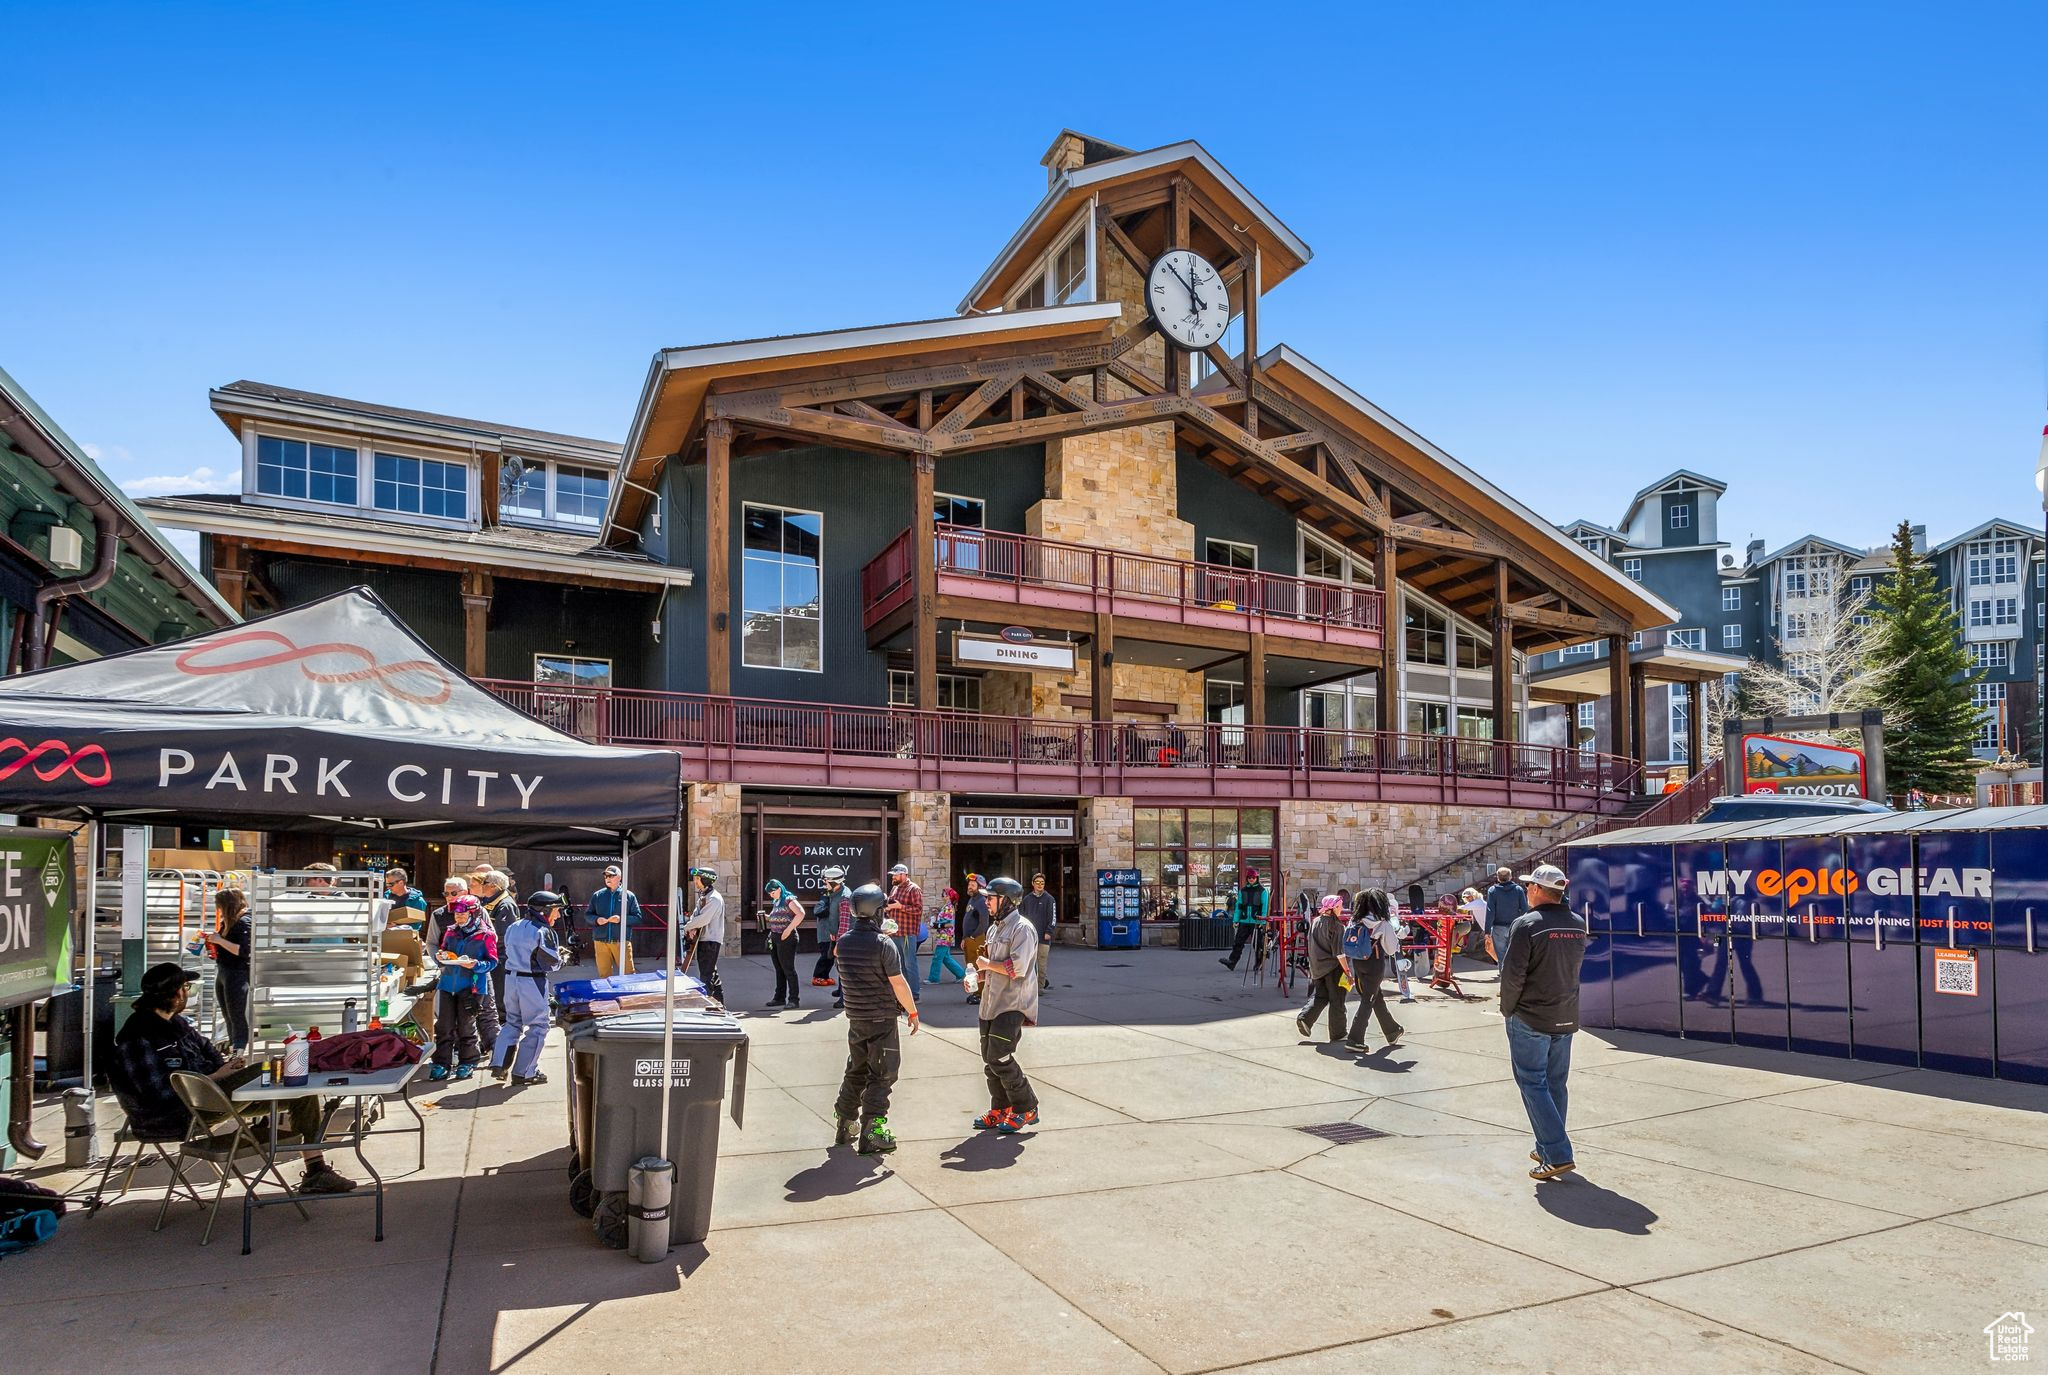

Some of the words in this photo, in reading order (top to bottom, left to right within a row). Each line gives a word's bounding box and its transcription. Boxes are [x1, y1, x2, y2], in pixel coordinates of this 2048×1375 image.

[996, 648, 1038, 660] DINING
[158, 748, 352, 798] PARK
[387, 764, 543, 810] CITY
[1783, 783, 1860, 796] TOYOTA
[804, 846, 833, 856] PARK
[836, 847, 864, 856] CITY
[793, 864, 850, 876] LEGY
[45, 876, 59, 886] ZERO
[1114, 872, 1136, 882] pepsi
[797, 878, 827, 889] LOD
[1697, 870, 1752, 895] MY
[1756, 867, 1859, 909] epic
[1866, 867, 1992, 898] GEAR
[1730, 914, 1752, 923] THAN
[1754, 915, 1797, 923] RENTING
[1802, 915, 1835, 924] ESIER
[632, 1078, 663, 1087] GLASS
